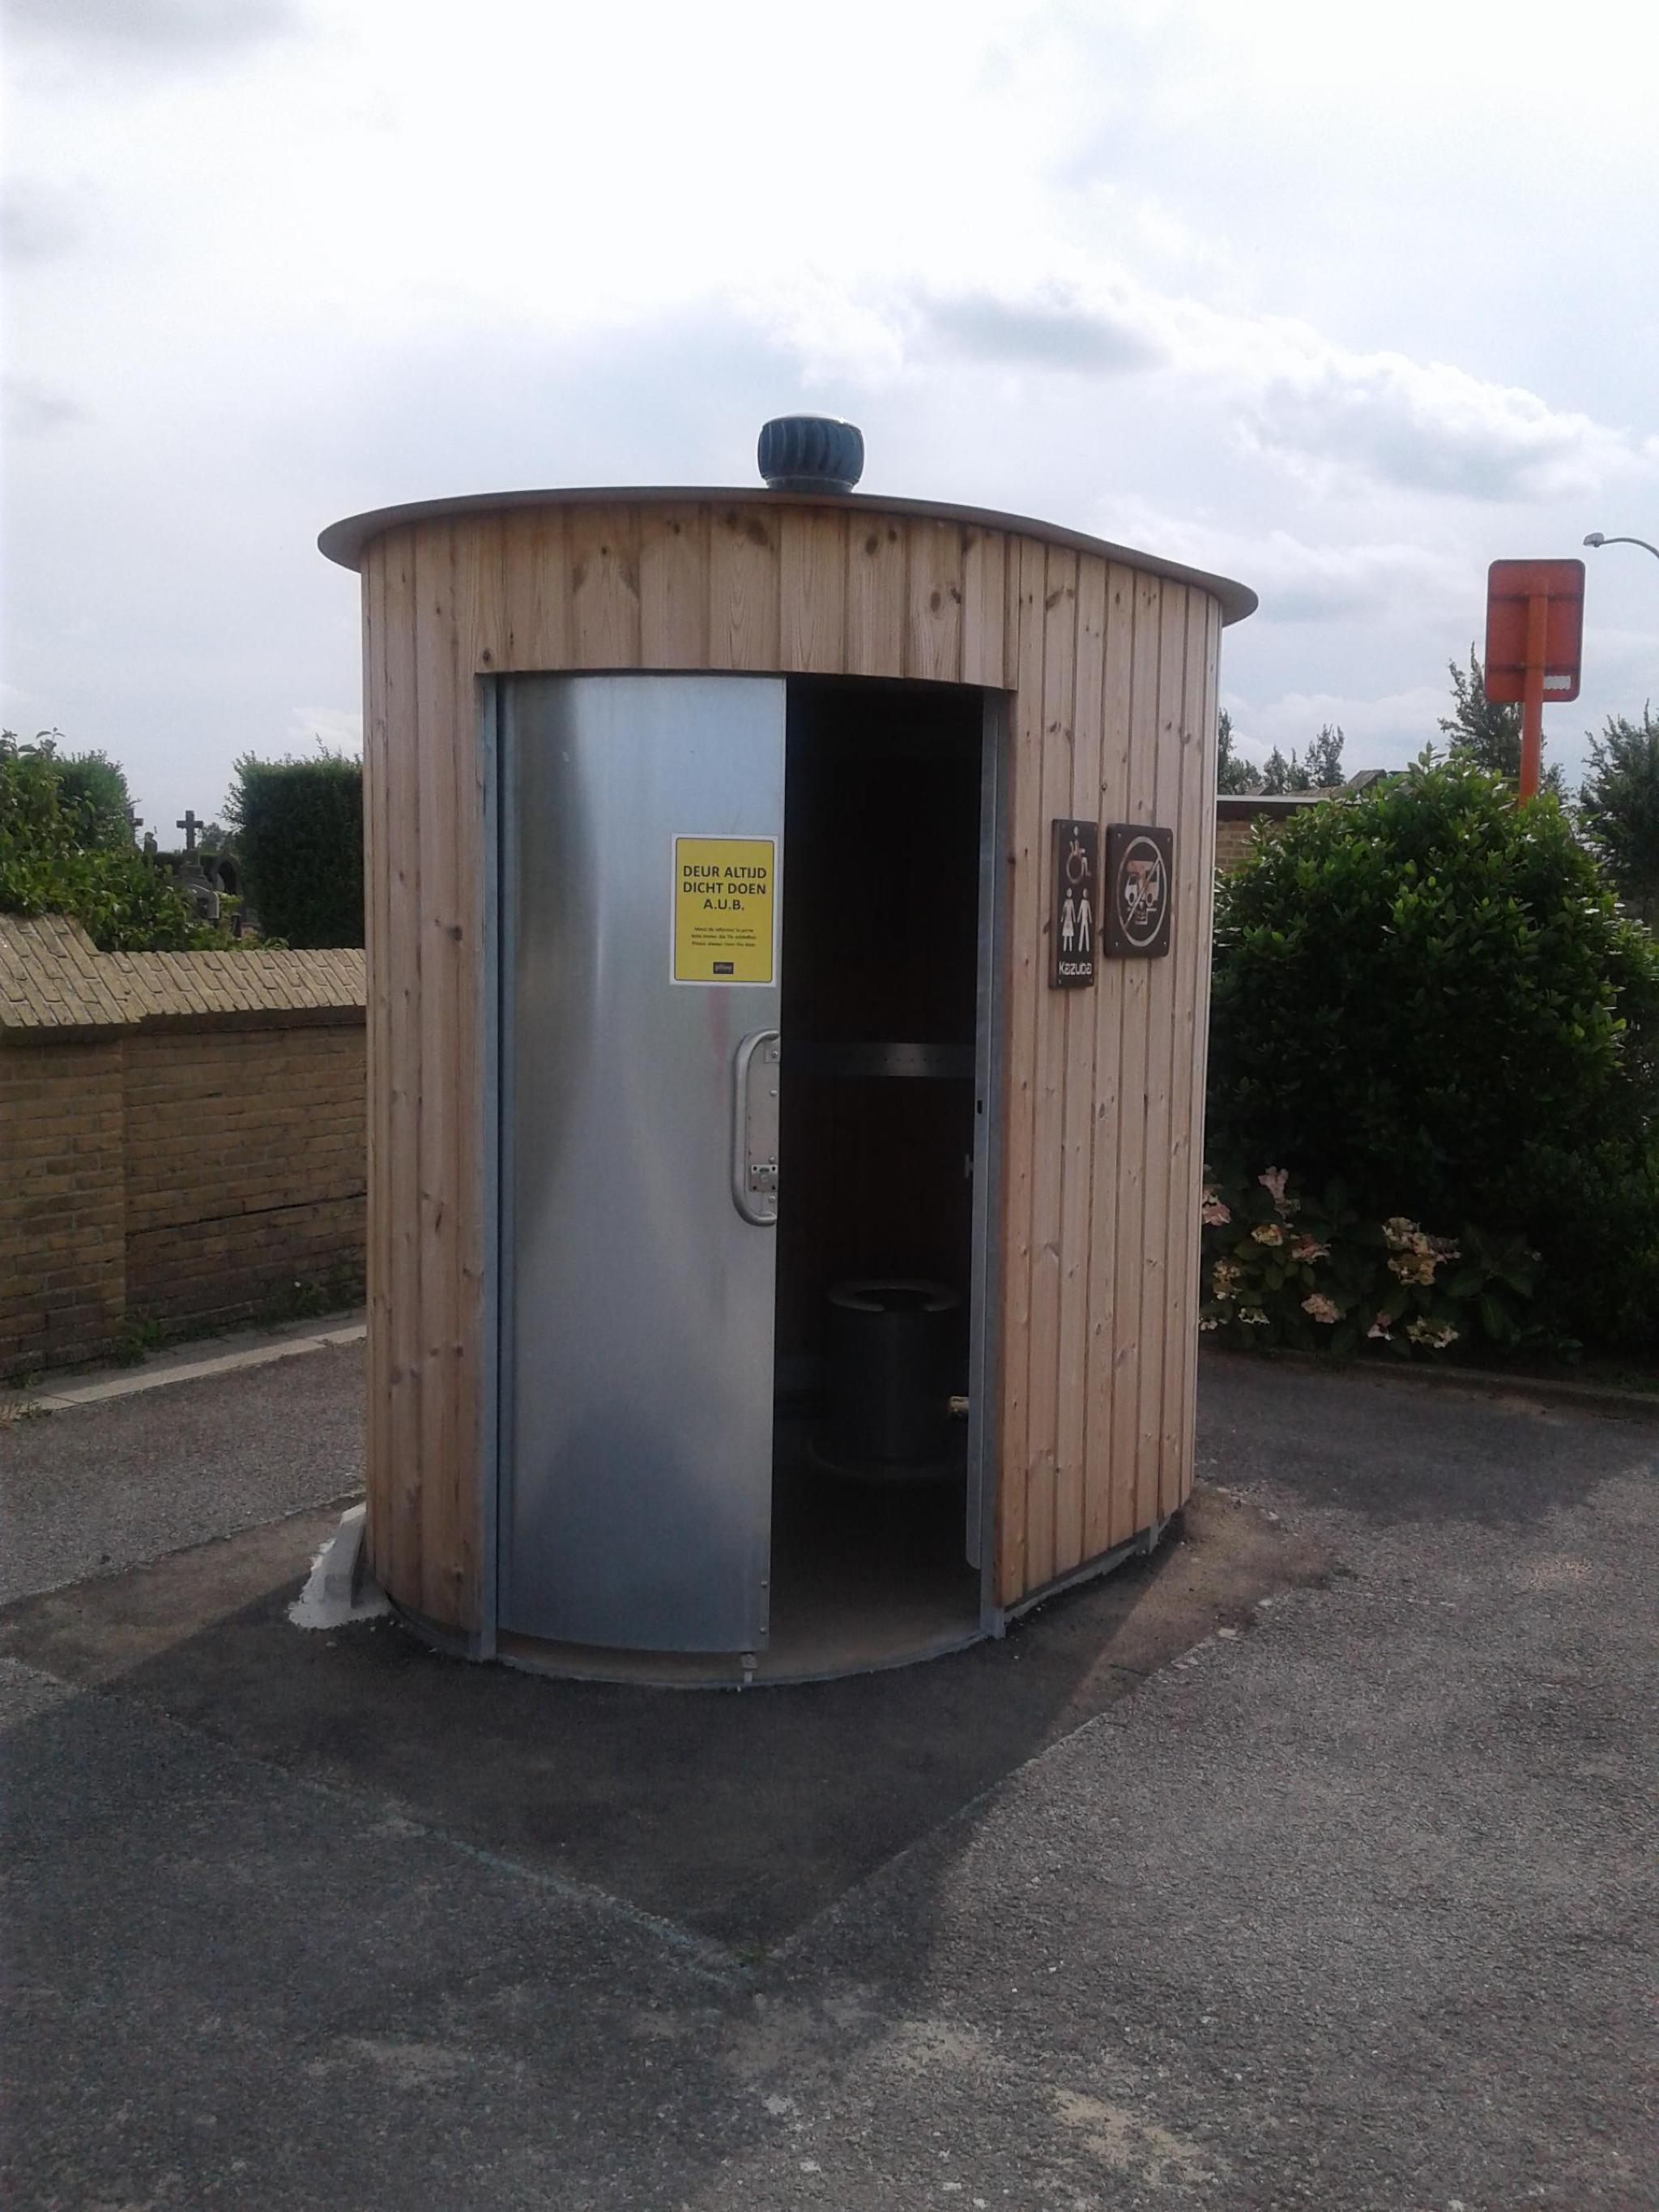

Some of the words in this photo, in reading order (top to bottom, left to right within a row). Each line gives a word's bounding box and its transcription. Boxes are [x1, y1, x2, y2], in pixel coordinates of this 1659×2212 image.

[683, 865, 719, 878] DEUR
[724, 867, 767, 878] ALTIJD
[683, 882, 723, 894] DICHT
[727, 883, 766, 895] DOEN
[703, 899, 745, 911] A.U.B.
